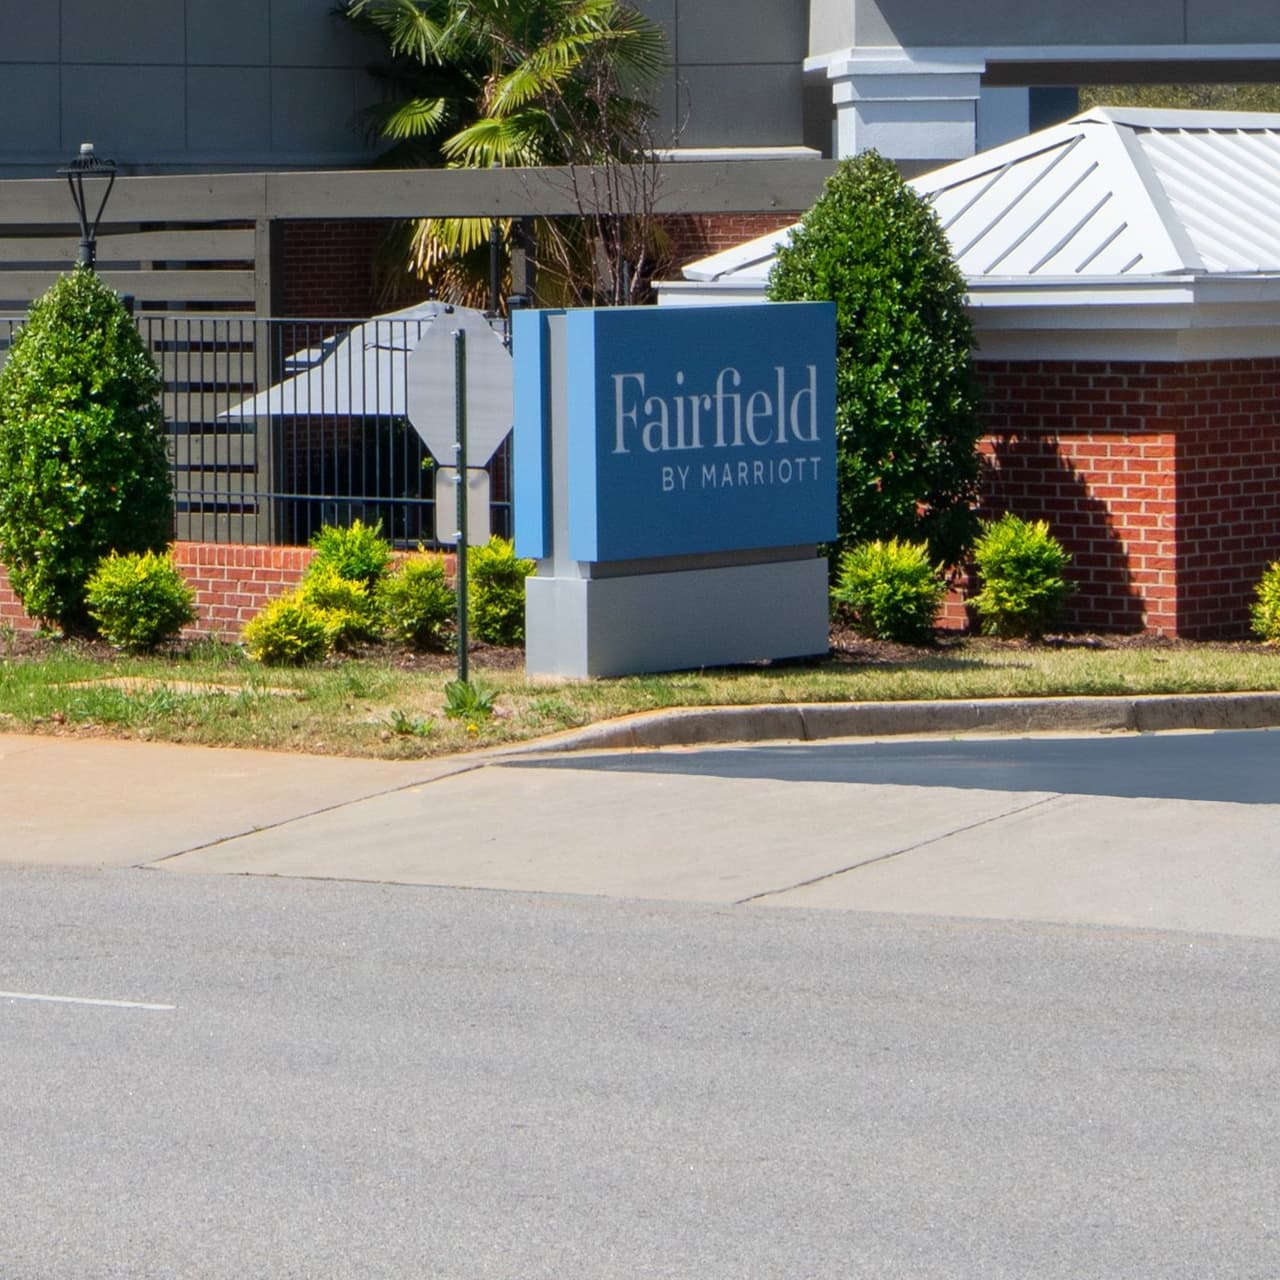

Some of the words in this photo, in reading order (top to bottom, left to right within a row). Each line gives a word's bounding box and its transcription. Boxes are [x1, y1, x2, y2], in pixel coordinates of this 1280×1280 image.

[611, 365, 821, 455] Fairfield
[662, 466, 691, 492] BY
[702, 456, 822, 488] MARRIOTT
